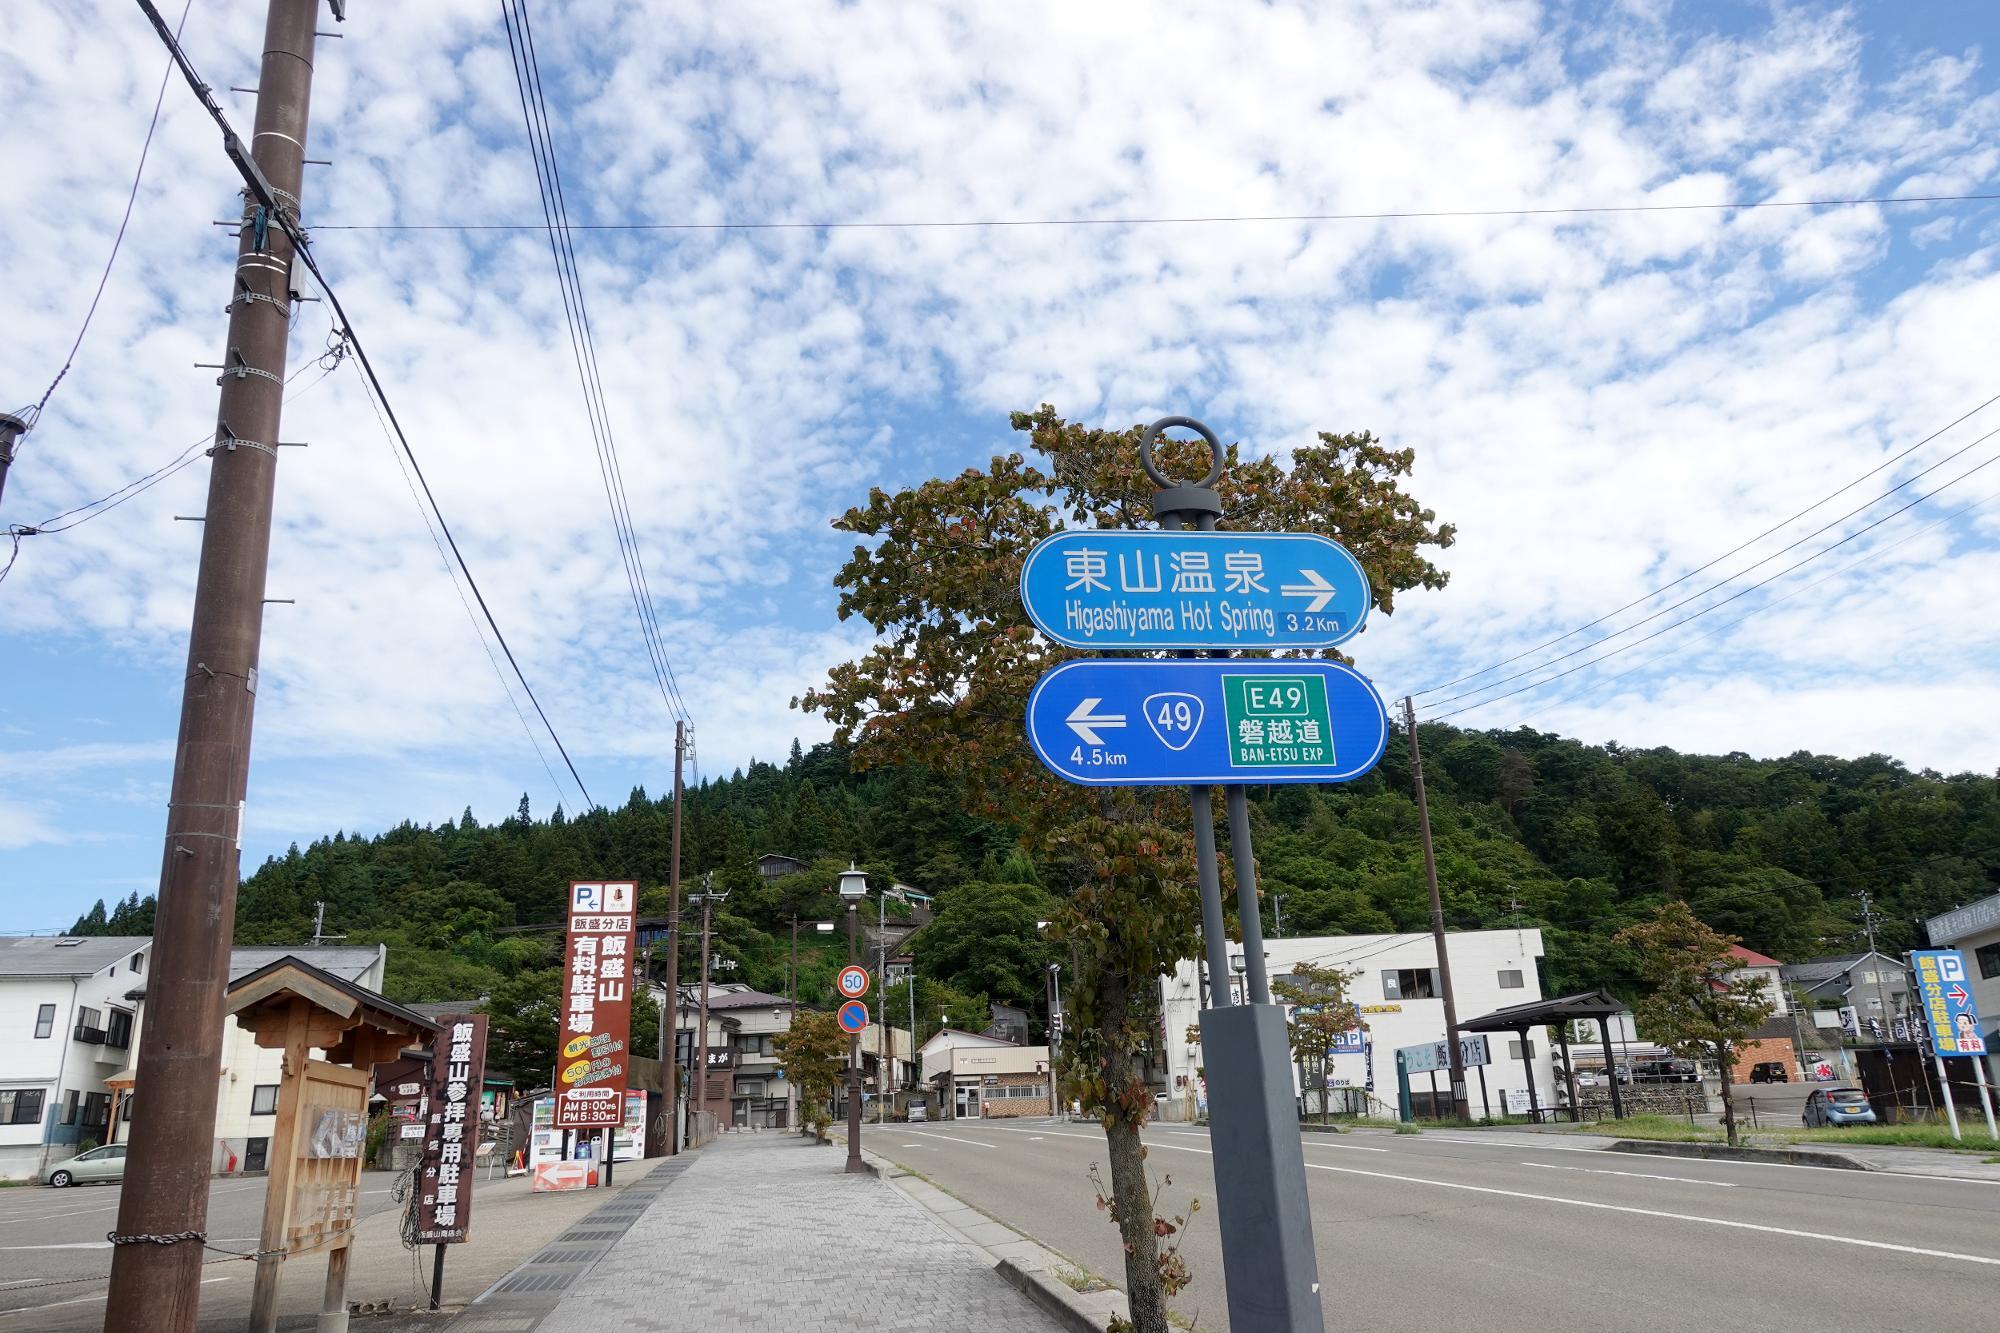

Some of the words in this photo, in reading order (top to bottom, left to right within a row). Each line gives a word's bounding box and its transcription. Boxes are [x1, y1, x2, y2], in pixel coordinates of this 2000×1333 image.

[1063, 547, 1270, 594] 東山温泉
[1066, 600, 1174, 637] Higashiyama
[1181, 600, 1213, 630] Hot
[1220, 600, 1275, 638] Spring
[1250, 687, 1301, 709] E49
[1158, 701, 1191, 731] 49
[1238, 719, 1322, 745] 磐越道
[1240, 748, 1298, 761] BAN-ETSU
[1303, 748, 1323, 761] EXP
[577, 887, 592, 904] P
[574, 918, 629, 930] 飯盛分店
[599, 935, 627, 1001] 飯盛山
[568, 935, 599, 1033] 有料駐車場
[845, 975, 862, 988] 50
[1960, 1040, 1981, 1051] 有料
[570, 1090, 610, 1099] ご利用時間
[564, 1101, 580, 1112] AM
[434, 1023, 474, 1227] 飯盛山参拝専用駐車場
[563, 1111, 579, 1122] PM
